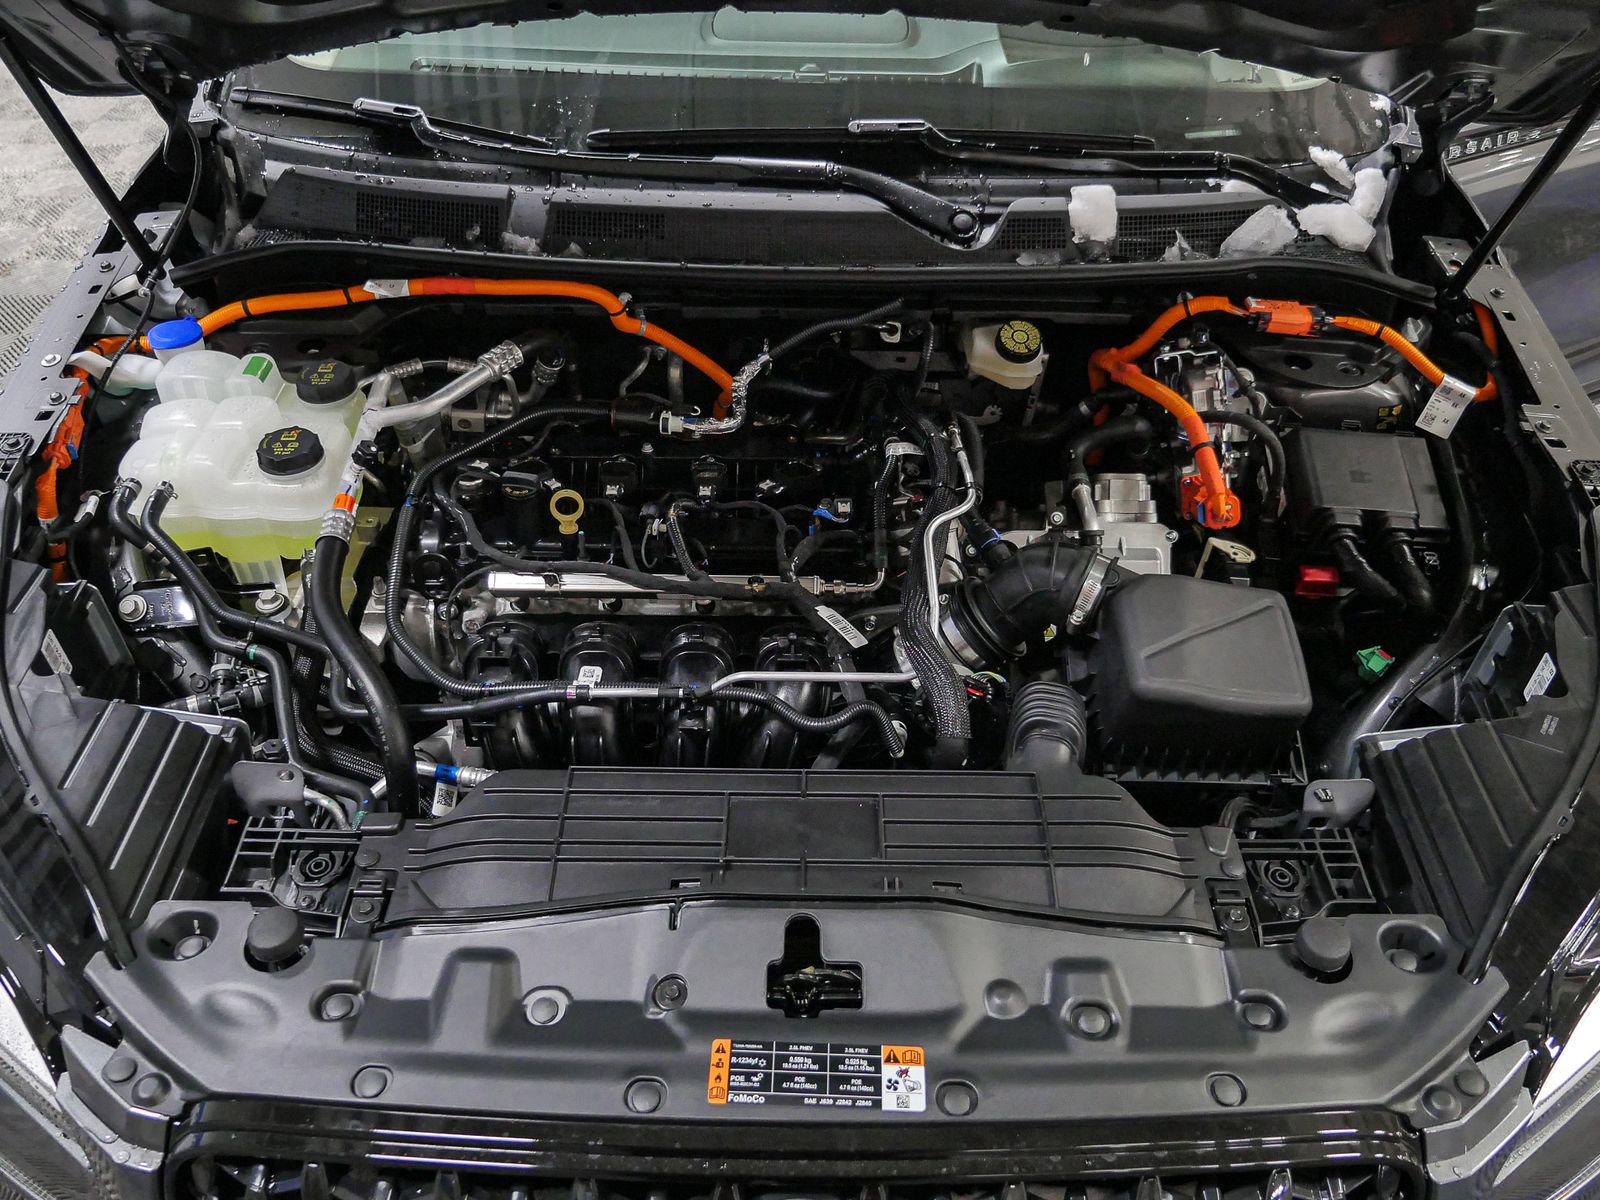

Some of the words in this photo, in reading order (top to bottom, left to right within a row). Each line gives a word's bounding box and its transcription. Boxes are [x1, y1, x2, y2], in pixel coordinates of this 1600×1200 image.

[731, 1057, 758, 1065] R-1234yf
[804, 1057, 812, 1065] kg
[859, 1058, 868, 1067] kg
[730, 1074, 745, 1082] POE
[728, 1093, 765, 1103] FoMoCo
